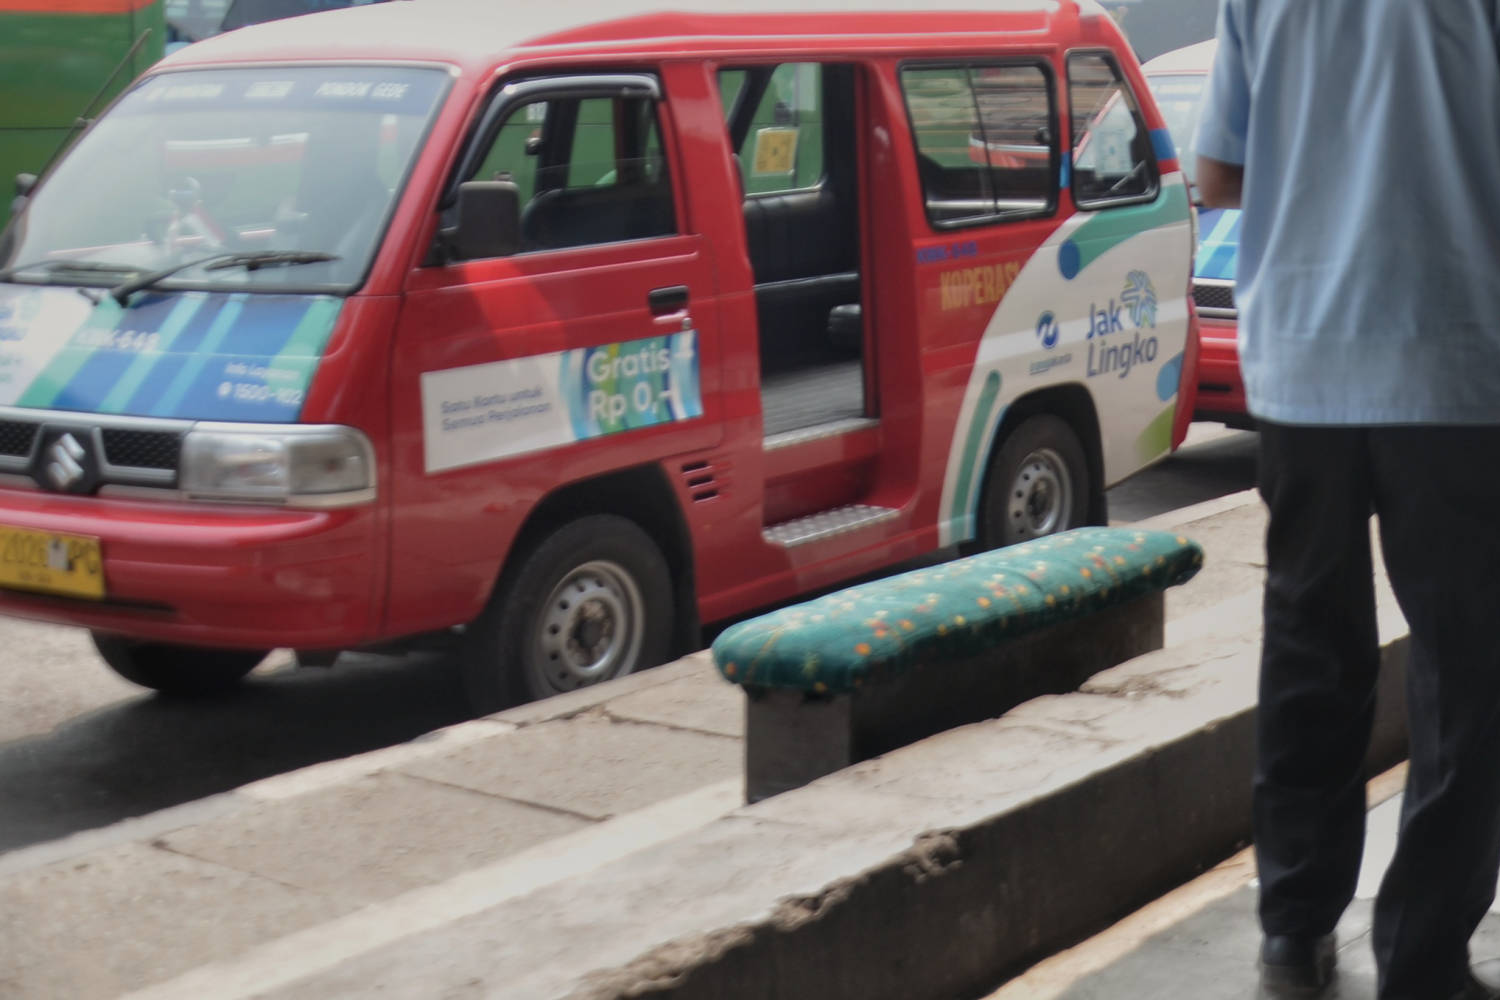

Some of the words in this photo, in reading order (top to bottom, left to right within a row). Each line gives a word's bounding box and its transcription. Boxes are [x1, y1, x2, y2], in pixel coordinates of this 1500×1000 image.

[1086, 297, 1124, 340] Jak
[587, 344, 672, 384] Gratis
[1087, 332, 1158, 379] Lingko
[589, 388, 625, 426] Rp
